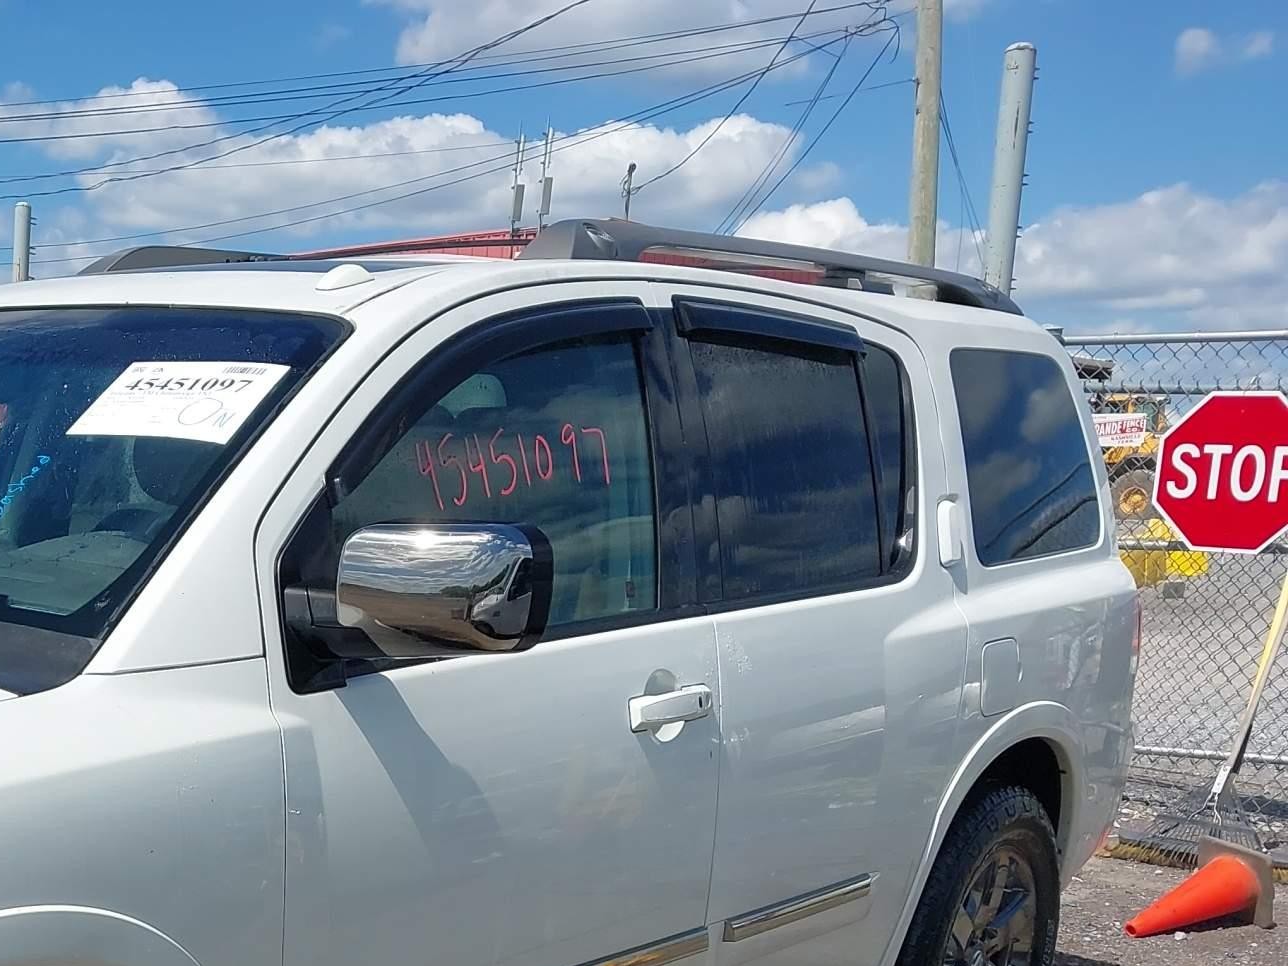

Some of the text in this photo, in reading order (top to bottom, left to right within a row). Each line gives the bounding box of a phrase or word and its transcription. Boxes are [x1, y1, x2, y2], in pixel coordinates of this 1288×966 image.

[125, 378, 254, 392] 45451097
[1121, 419, 1144, 432] FENCE
[416, 423, 610, 511] 45451097
